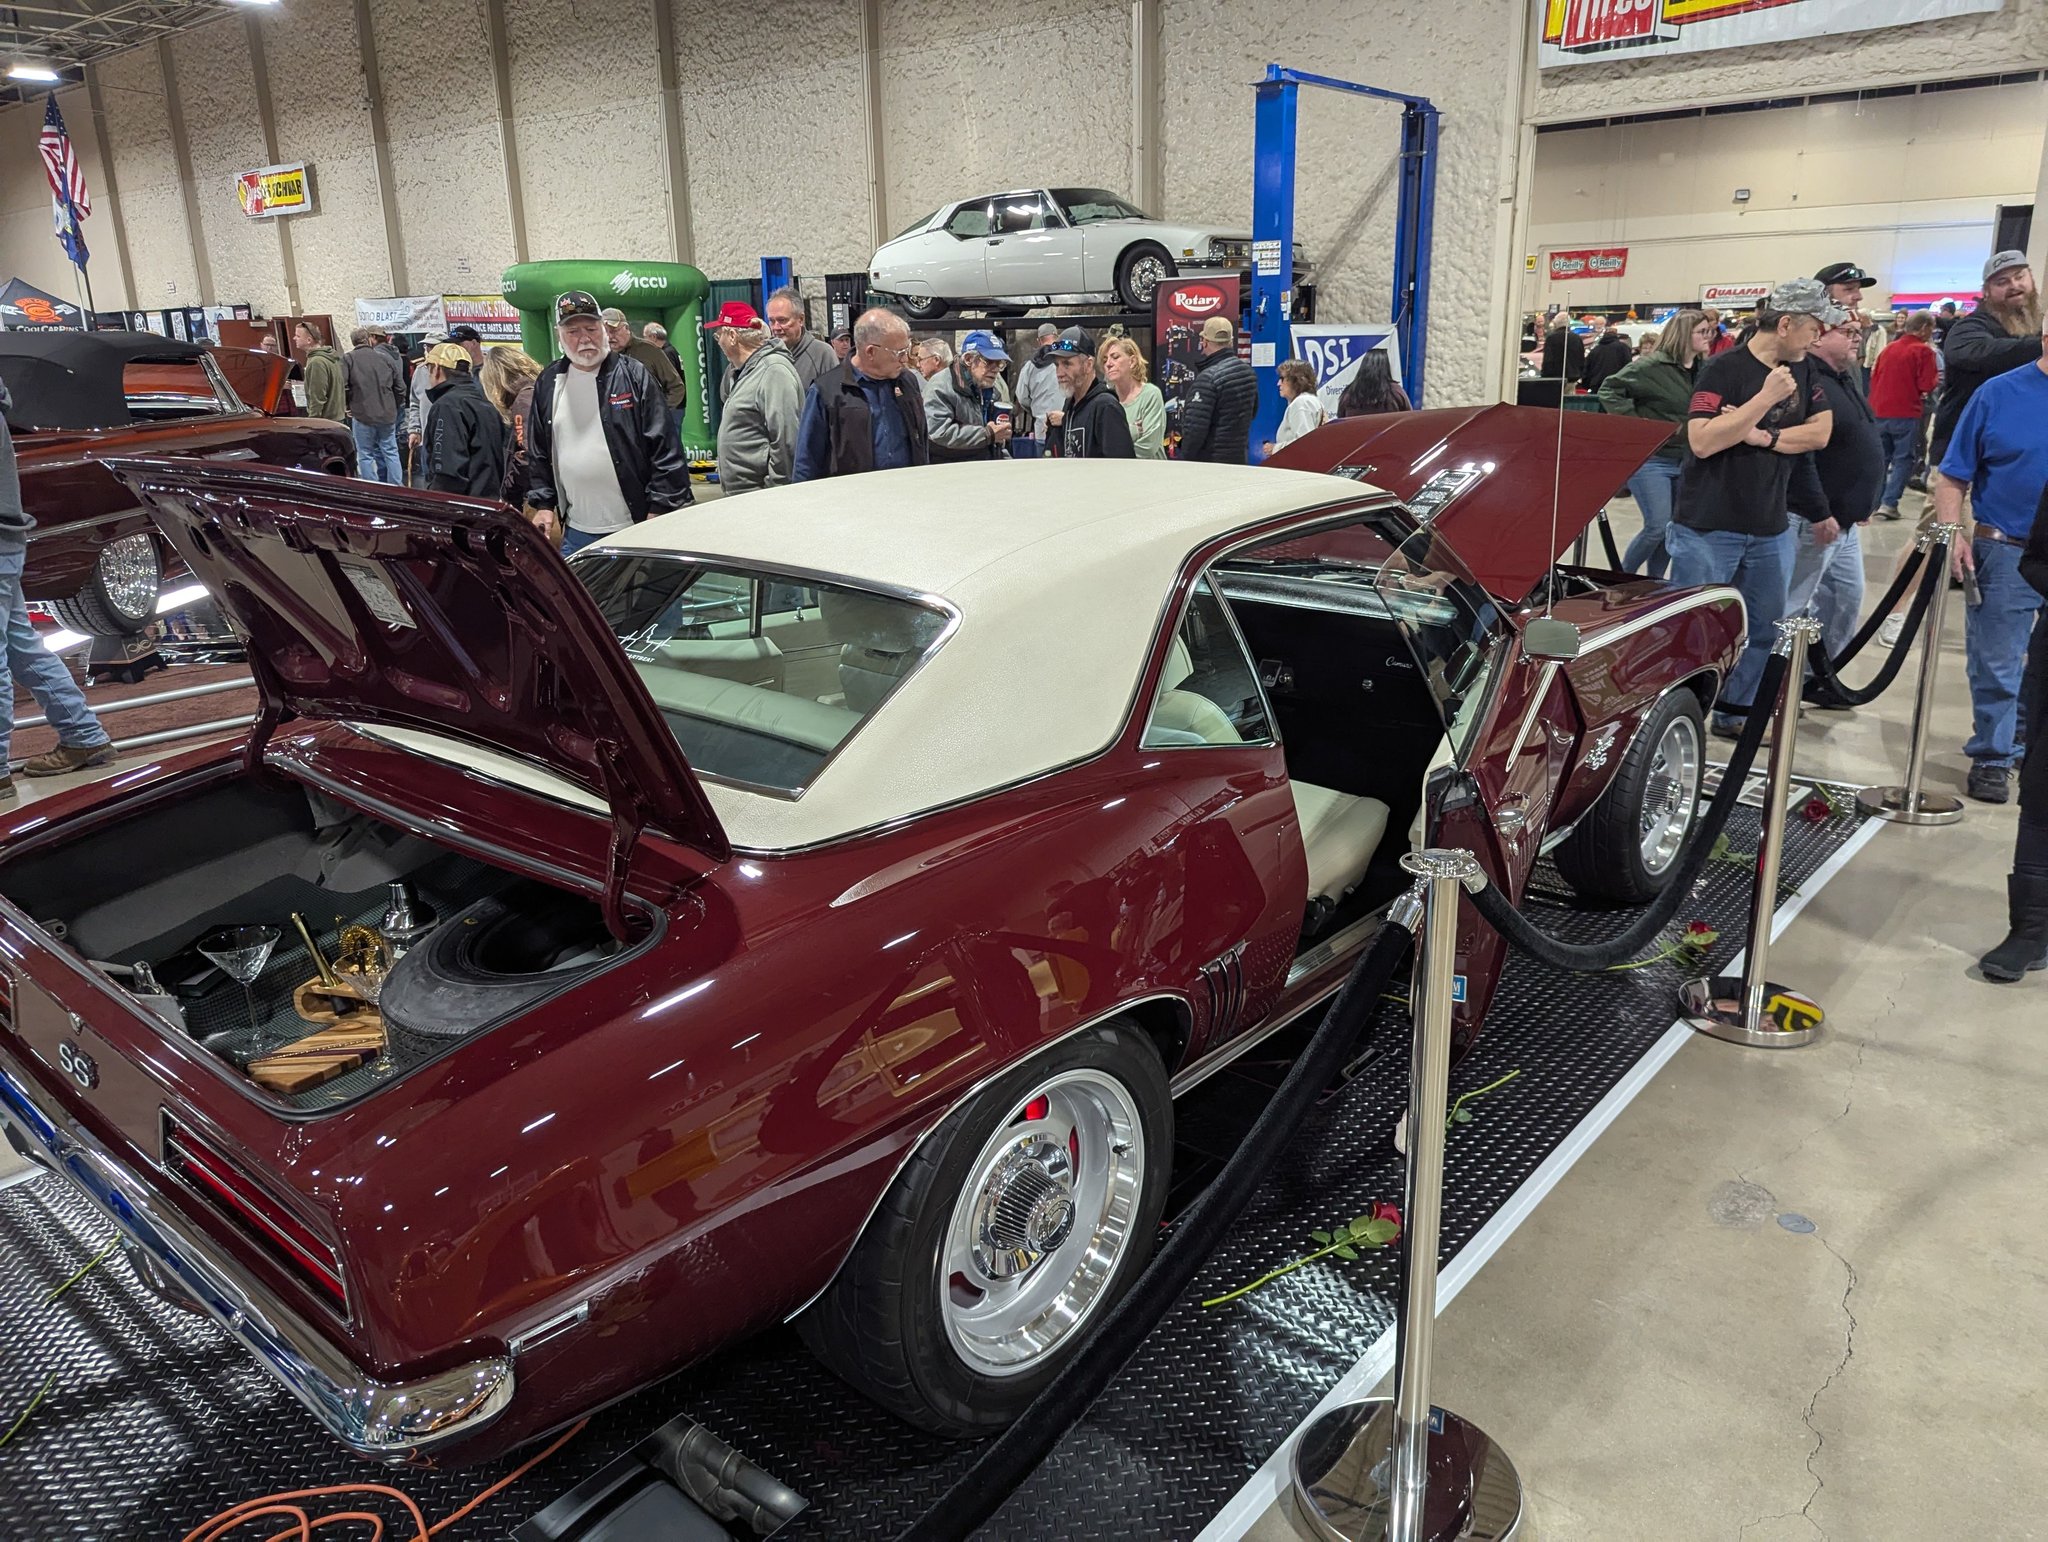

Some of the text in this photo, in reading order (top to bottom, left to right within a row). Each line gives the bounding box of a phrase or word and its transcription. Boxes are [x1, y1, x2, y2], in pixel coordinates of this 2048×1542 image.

[634, 276, 668, 289] ICCU
[1174, 291, 1221, 312] Rotary
[1705, 287, 1767, 300] QUALAFAB
[447, 300, 493, 318] PERFORMANCE
[503, 323, 514, 332] AND
[694, 315, 710, 424] ICCU.COM
[1304, 338, 1352, 388] DSI
[1385, 656, 1413, 669] Camaro
[59, 1042, 90, 1088] SS
